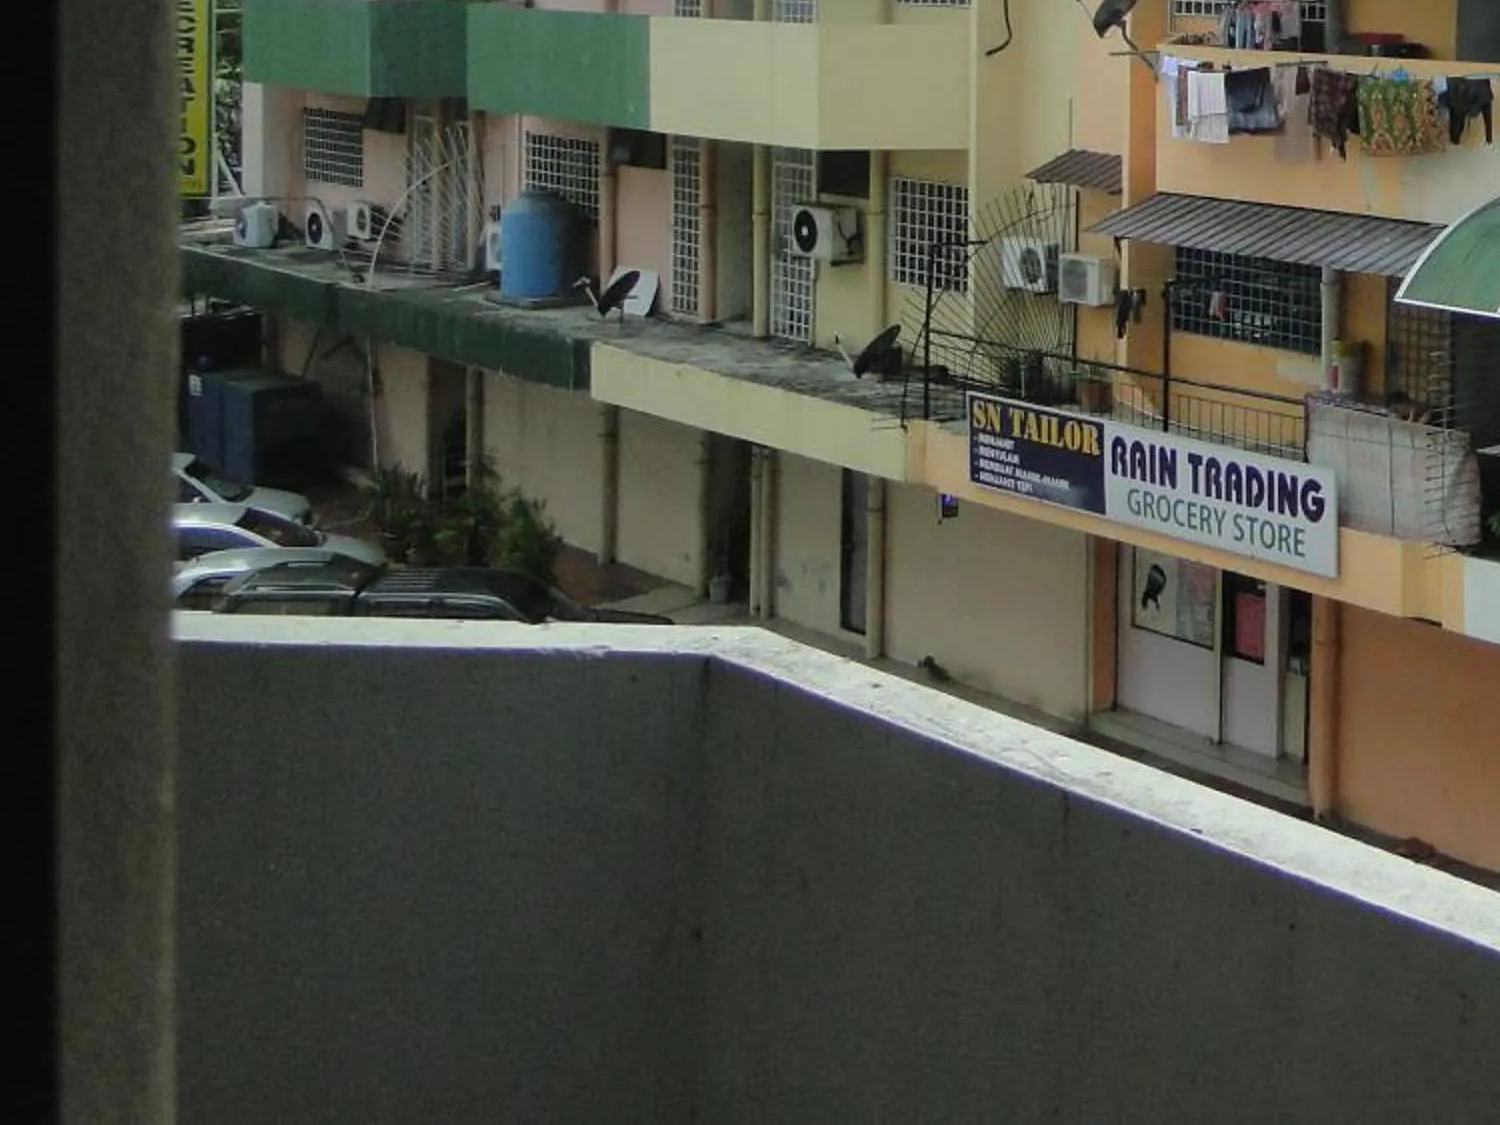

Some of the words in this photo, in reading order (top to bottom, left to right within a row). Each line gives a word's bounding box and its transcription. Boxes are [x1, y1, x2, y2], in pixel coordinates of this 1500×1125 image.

[972, 400, 1001, 432] SN
[1007, 410, 1101, 456] TAILOR
[1112, 436, 1177, 490] RAIN
[1188, 452, 1325, 523] TRADING
[1127, 488, 1225, 538] GROCERY
[1233, 512, 1306, 557] STORE
